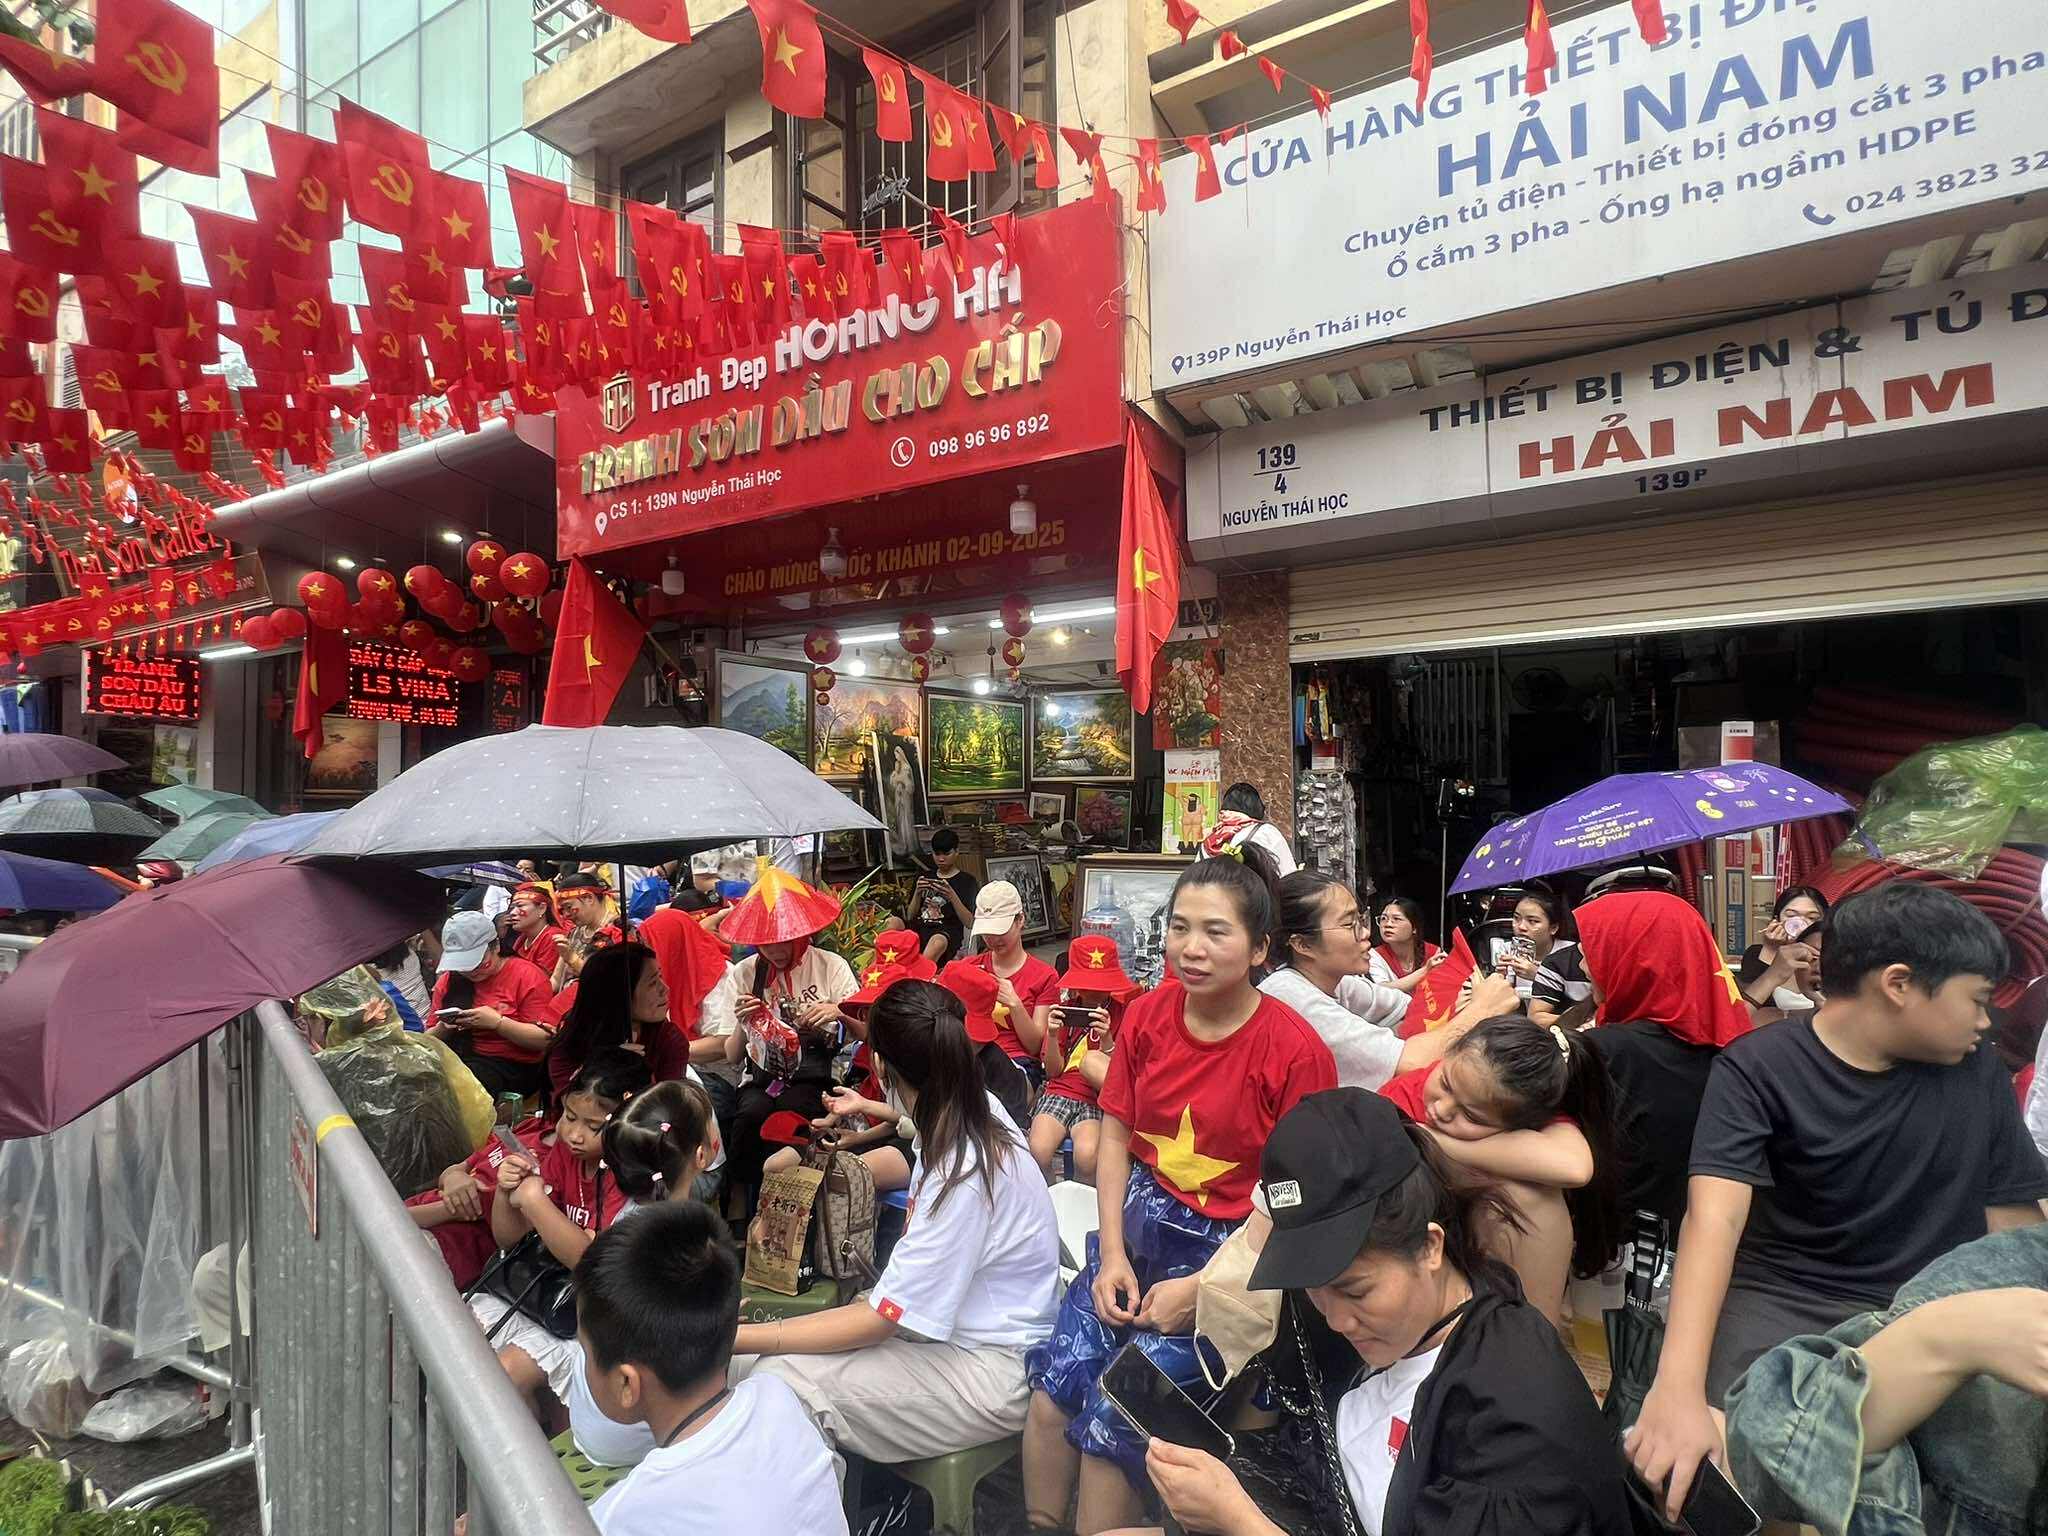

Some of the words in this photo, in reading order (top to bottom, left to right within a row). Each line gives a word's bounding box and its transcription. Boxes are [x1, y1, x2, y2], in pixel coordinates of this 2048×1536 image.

[1224, 137, 1311, 187] CỬA
[1326, 84, 1461, 156] HÀNG
[1437, 99, 1588, 198] HẢI
[1623, 15, 1875, 145] NAM
[1344, 211, 1449, 254] Chuyên
[1457, 198, 1488, 225] tủ
[1497, 180, 1566, 210] điện
[1593, 143, 1682, 187] Thiết
[1692, 132, 1726, 161] bị
[1737, 106, 1837, 149] đóng
[1849, 82, 1911, 118] cắt
[1923, 73, 1947, 98] 3
[1961, 50, 2046, 94] pha
[1386, 250, 1408, 278] Ổ
[1415, 242, 1475, 272] cắm
[1483, 234, 1501, 255] 3
[1511, 218, 1570, 253] pha
[1599, 193, 1670, 224] Ống
[1681, 178, 1725, 205] hạ
[1736, 147, 1845, 191] ngầm
[1859, 109, 1977, 160] HDPE
[1846, 185, 1905, 214] 024
[1915, 163, 1999, 194] 3823
[1186, 346, 1230, 369] 139P
[1235, 327, 1311, 358] Nguyễn
[1315, 315, 1360, 338] Thái
[1365, 306, 1408, 326] Học
[1419, 375, 1558, 432] THIẾT
[1575, 371, 1623, 405] BỊ
[1649, 337, 1790, 390] ĐIỆN
[1814, 326, 1864, 360] &
[1890, 289, 1984, 342] TỦ
[579, 427, 682, 496] TRANH
[688, 406, 764, 469] SƠN
[771, 371, 853, 448] DẦU
[861, 354, 951, 424] CAO
[961, 311, 1064, 398] CẤP
[648, 366, 710, 413] Tranh
[719, 355, 768, 392] Đẹp
[928, 438, 960, 459] 098
[965, 431, 986, 450] 96
[990, 423, 1011, 443] 96
[1016, 413, 1050, 435] 892
[1517, 412, 1675, 479] HẢI
[1718, 361, 1995, 447] NAM
[1256, 443, 1297, 470] 139
[1273, 472, 1288, 495] 4
[609, 501, 628, 521] CS
[632, 498, 643, 514] 1:
[646, 490, 678, 512] 139N
[682, 478, 725, 506] Nguyễn
[728, 473, 754, 493] Thái
[757, 467, 782, 487] Học
[1222, 500, 1278, 528] NGUYỄN
[1281, 495, 1314, 518] THÁI
[1318, 493, 1349, 515] HỌC
[724, 569, 765, 596] CHÀO
[825, 546, 873, 583] ỐC
[876, 539, 942, 573] KHÁNH
[362, 672, 392, 694] LS
[397, 677, 451, 700] VINA
